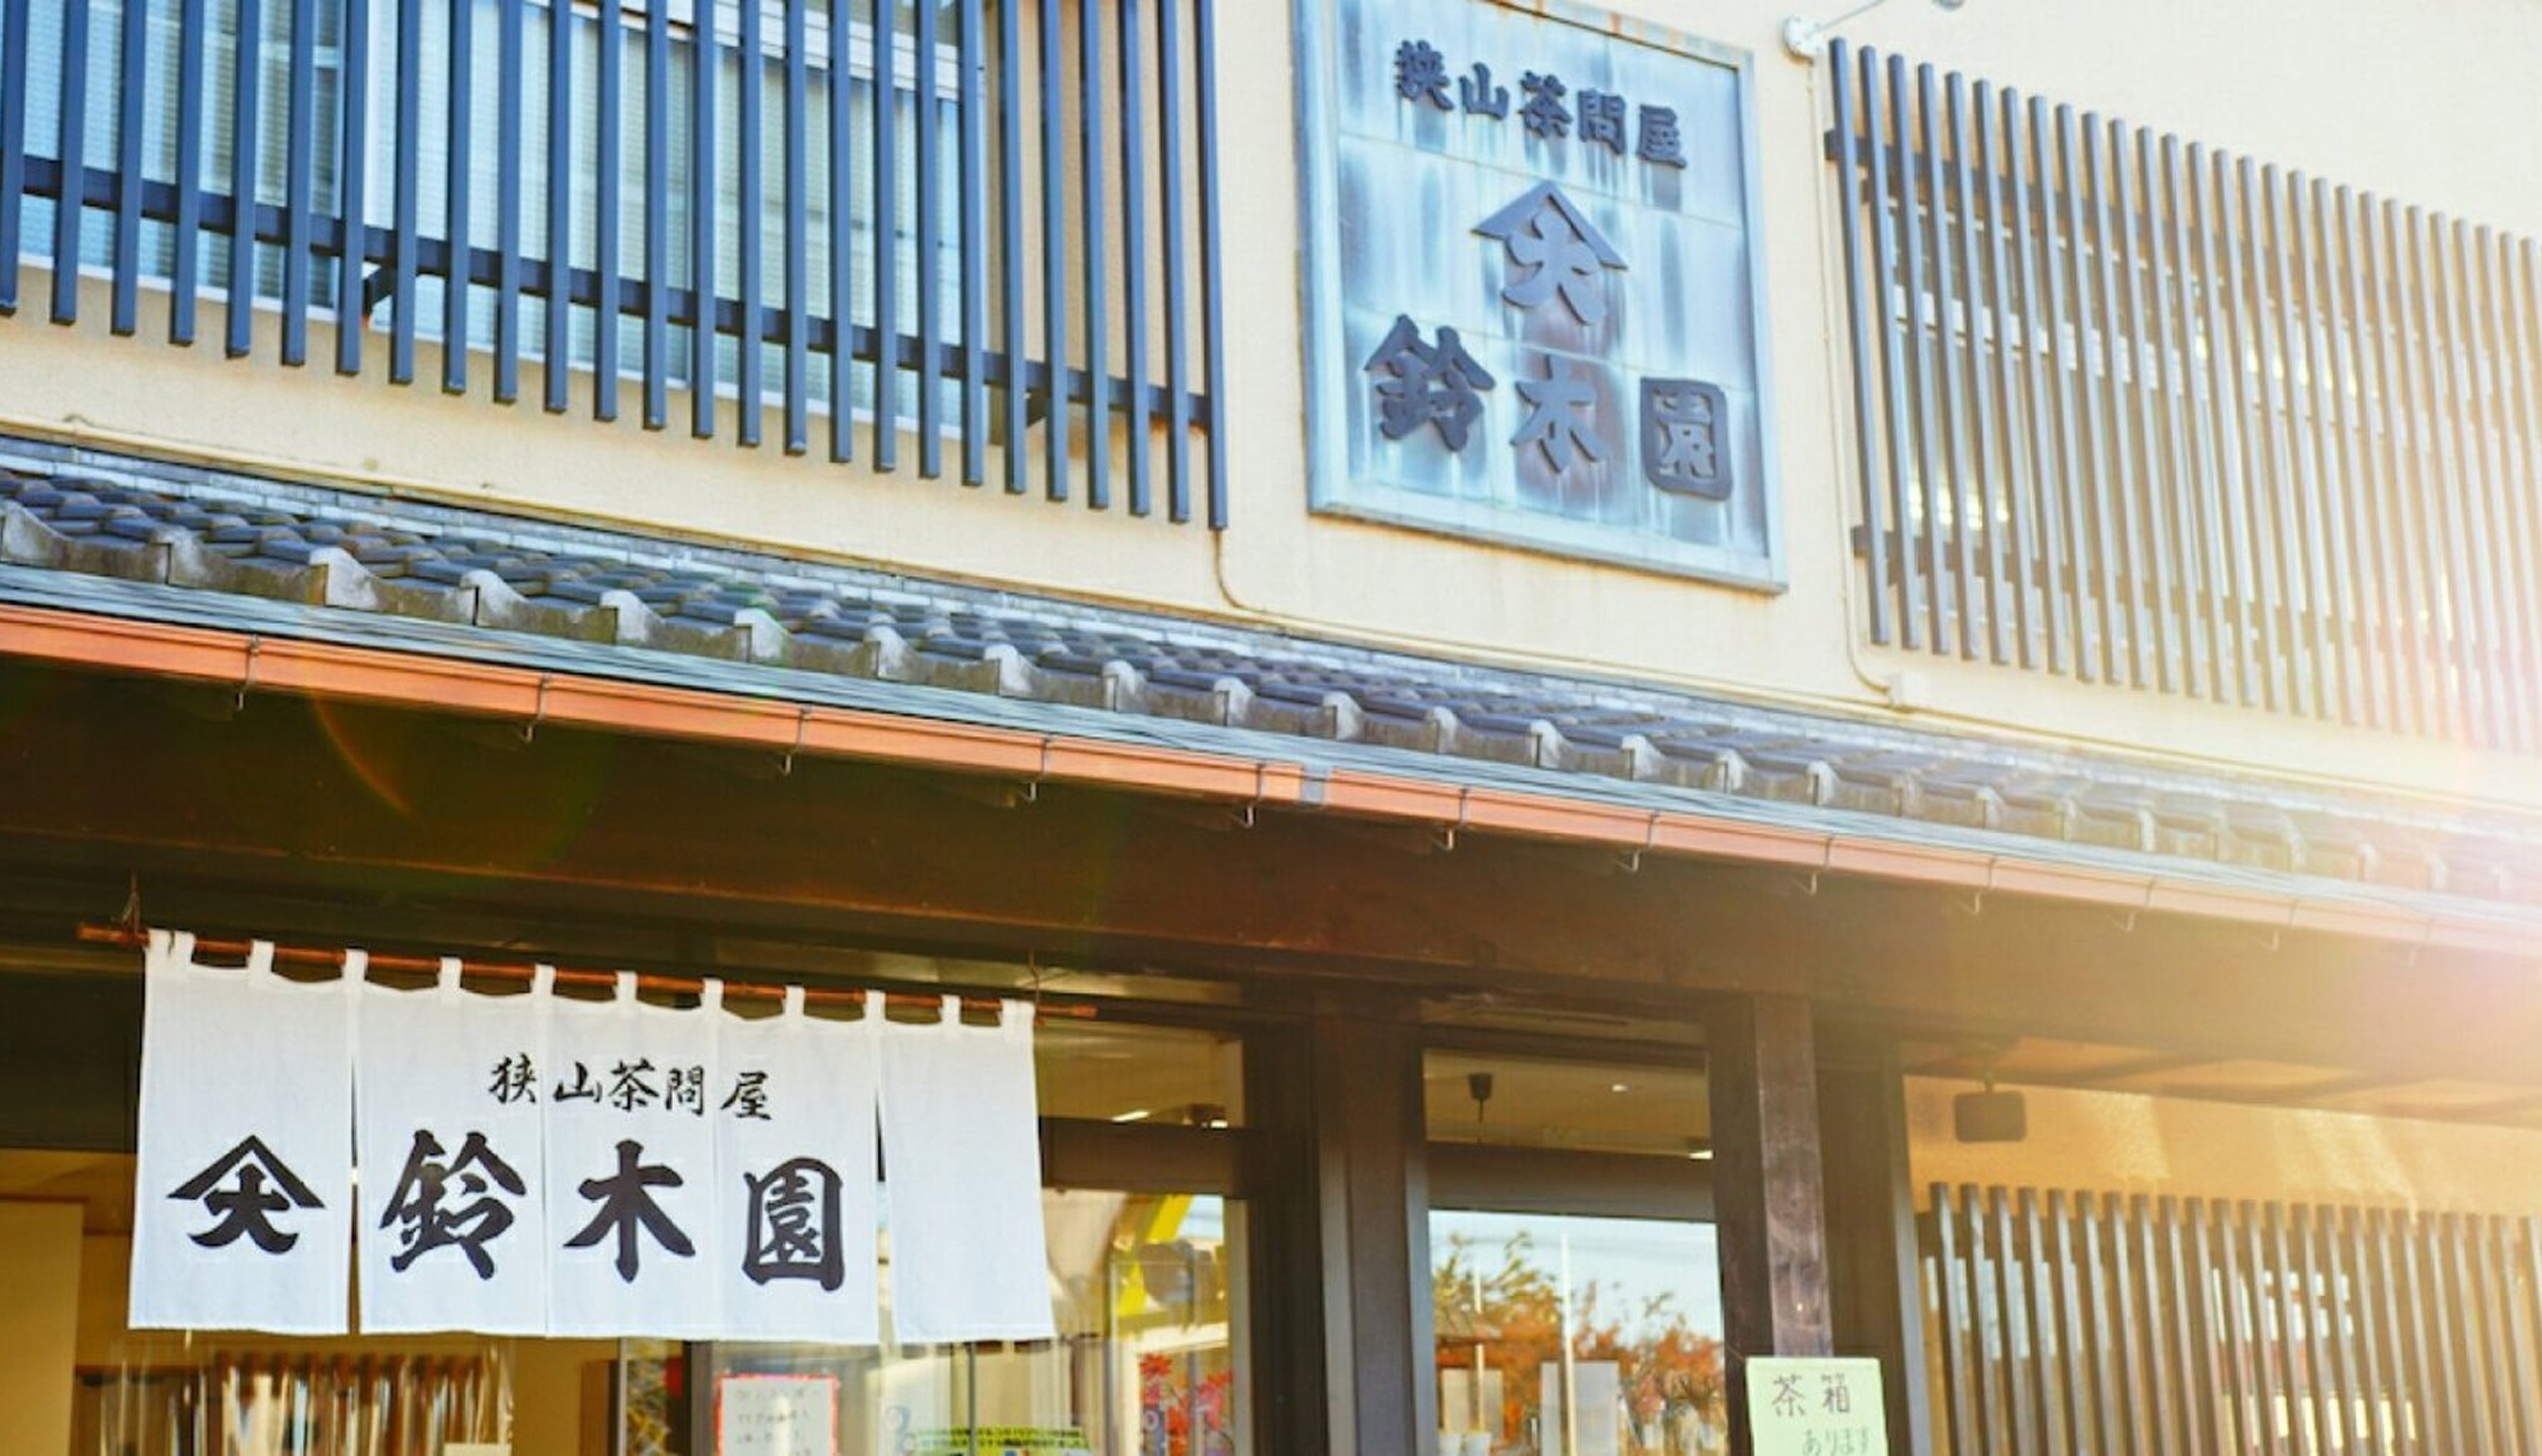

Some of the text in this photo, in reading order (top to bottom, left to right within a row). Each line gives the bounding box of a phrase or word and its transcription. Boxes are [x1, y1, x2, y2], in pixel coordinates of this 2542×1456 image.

[1394, 39, 1687, 169] 狭山茶問屋
[1363, 313, 1734, 502] 鈴木園
[487, 1051, 773, 1122] 狭山茶問屋
[379, 1128, 846, 1293] 鈴木園
[1771, 1373, 1852, 1417] 茶箱
